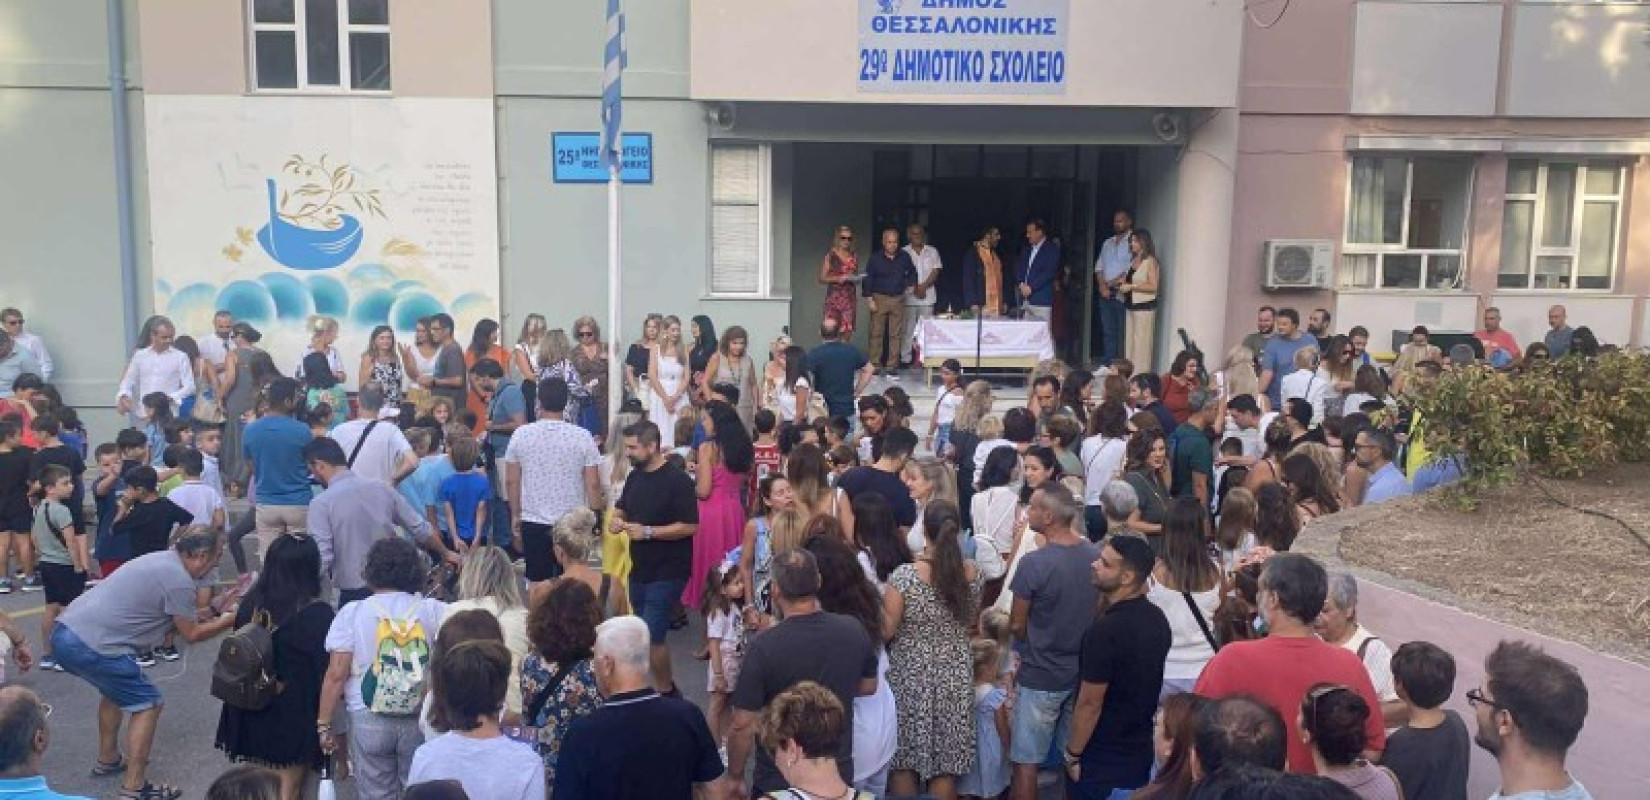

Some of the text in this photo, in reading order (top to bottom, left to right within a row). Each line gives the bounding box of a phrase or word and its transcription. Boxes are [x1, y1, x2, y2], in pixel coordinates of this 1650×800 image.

[871, 16, 1057, 35] ΘΕΣΣΑΛΟΝΙΚΗΣ
[892, 49, 985, 82] ΔΗΜΟΤΙΚΟ
[989, 50, 1065, 83] ΣΧΟΛΕΙΟ
